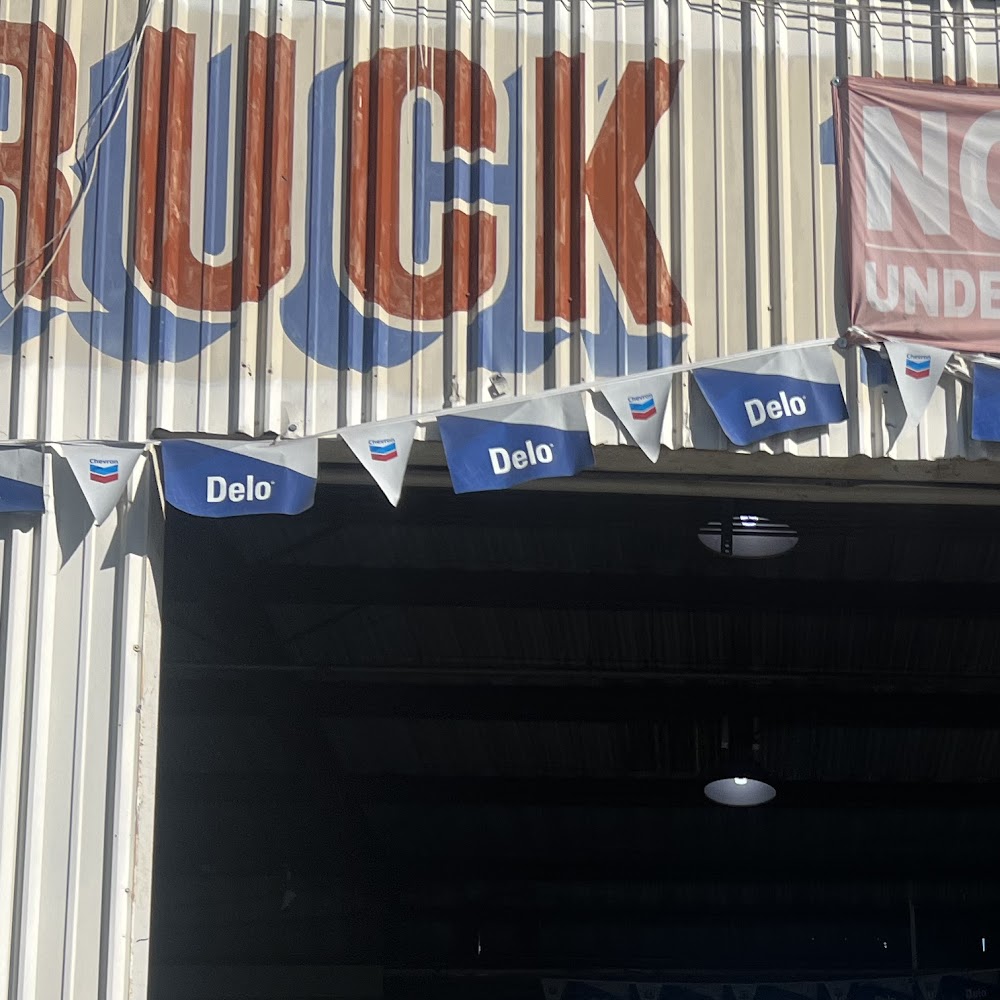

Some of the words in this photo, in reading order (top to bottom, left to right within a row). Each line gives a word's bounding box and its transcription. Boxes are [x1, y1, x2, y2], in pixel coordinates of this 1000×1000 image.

[744, 391, 807, 428] Delo
[488, 440, 553, 476] Delo
[206, 474, 272, 503] Delo
